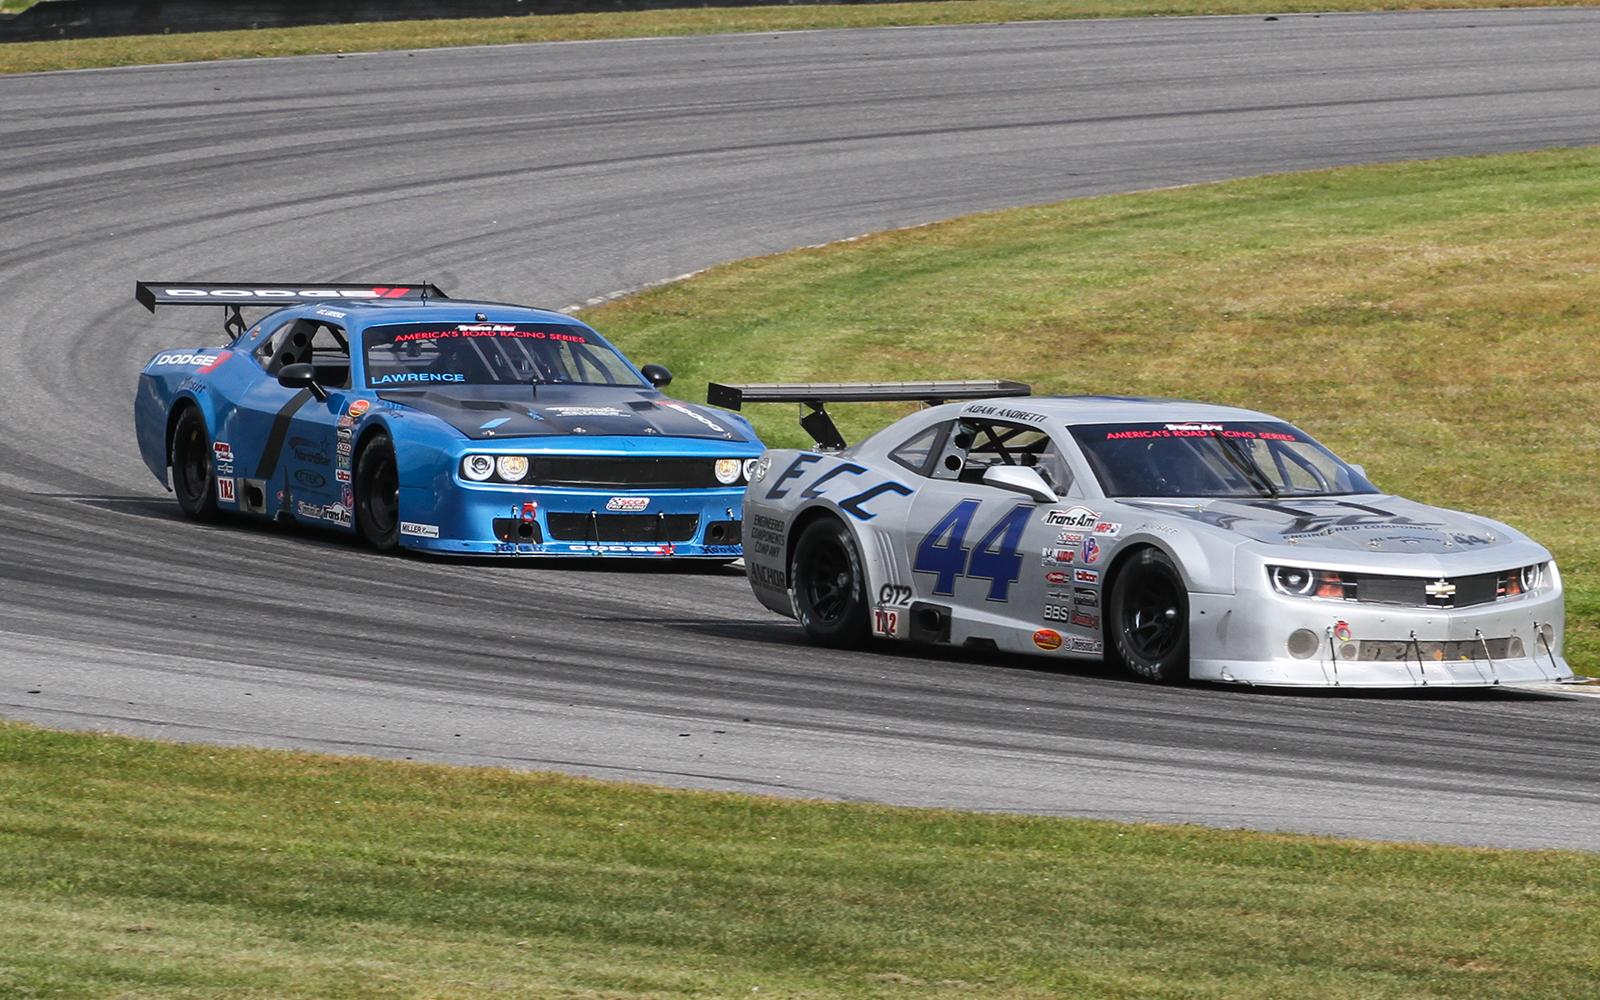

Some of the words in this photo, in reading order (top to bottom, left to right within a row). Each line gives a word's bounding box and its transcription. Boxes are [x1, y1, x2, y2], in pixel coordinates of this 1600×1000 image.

[165, 289, 381, 298] DODGE
[394, 331, 459, 342] AMERICA'S
[500, 331, 545, 339] RACING
[549, 333, 586, 344] SERIES
[157, 355, 217, 366] DODGE
[371, 373, 465, 384] LAWRENCE
[963, 404, 998, 415] ADAM
[997, 409, 1048, 423] ANDRETTI
[1107, 431, 1170, 440] AMERICA'S
[1259, 432, 1296, 441] SERIES
[765, 452, 915, 521] ECC
[322, 507, 340, 520] Trans
[1046, 511, 1076, 526] Trans
[1075, 514, 1096, 527] Am
[402, 524, 421, 533] MILLER
[1095, 523, 1112, 532] HRP
[1453, 535, 1490, 546] 44
[912, 498, 1037, 603] 44
[879, 582, 912, 606] GT2
[1044, 604, 1069, 622] BBS
